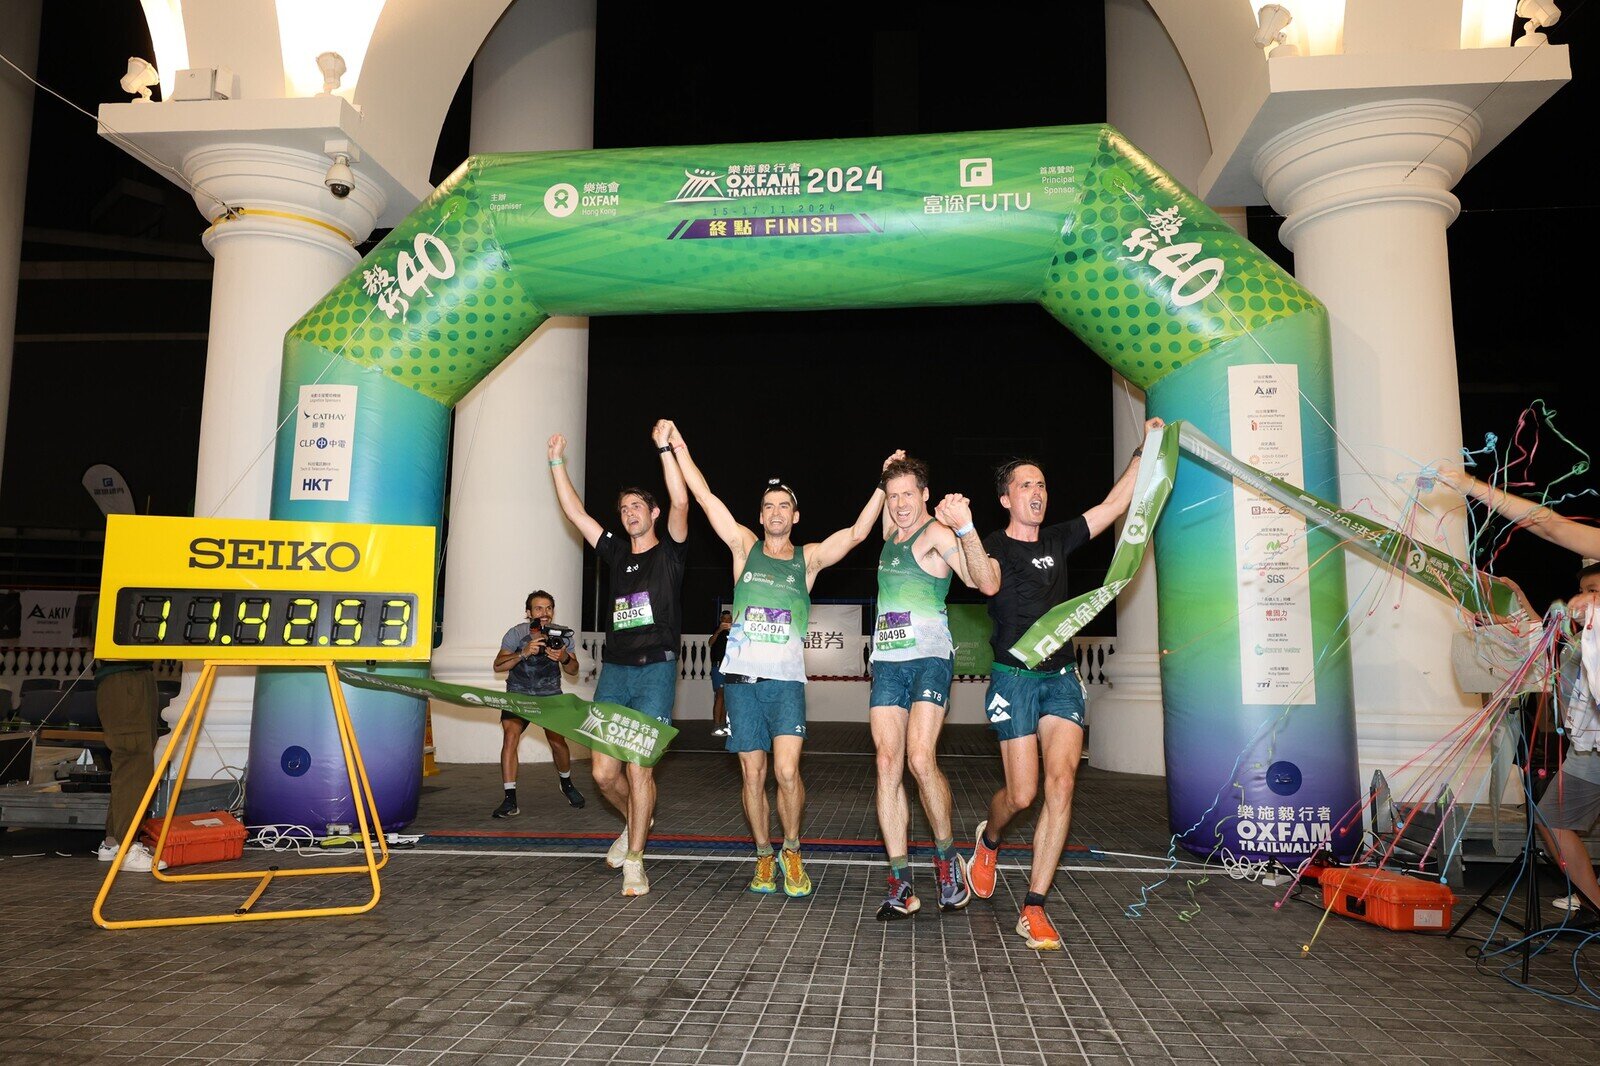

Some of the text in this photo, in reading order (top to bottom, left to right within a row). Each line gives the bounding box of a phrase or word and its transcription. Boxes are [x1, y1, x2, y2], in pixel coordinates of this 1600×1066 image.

[728, 163, 801, 174] 樂施毅行者
[726, 173, 801, 189] OXFAM
[807, 165, 883, 194] 2024
[1041, 176, 1075, 188] Principal
[583, 181, 620, 194] 樂施會
[727, 186, 801, 198] TRAILWALKER
[1044, 186, 1075, 195] Sponsor
[489, 202, 522, 212] Organiser
[582, 195, 619, 207] OXFAM
[582, 208, 599, 216] Hong
[765, 216, 838, 235] FINISH
[397, 232, 456, 298] 40
[1148, 242, 1225, 307] 40
[312, 413, 347, 421] CATHAY
[299, 439, 316, 448] CLP
[302, 478, 333, 491] HKT
[188, 537, 361, 573] SEIKO
[752, 577, 775, 586] running
[1267, 574, 1285, 584] SGS
[48, 607, 71, 619] AKIV
[616, 607, 645, 621] 8049C
[750, 622, 785, 634] 8049A
[804, 631, 844, 649] 證券
[879, 629, 907, 641] 8049B
[932, 691, 943, 702] T8
[608, 722, 657, 751] OXFAM
[1237, 804, 1332, 821] 樂施毅行者
[1236, 820, 1332, 842] OXFAM
[1238, 839, 1334, 853] TRAILWALKER
